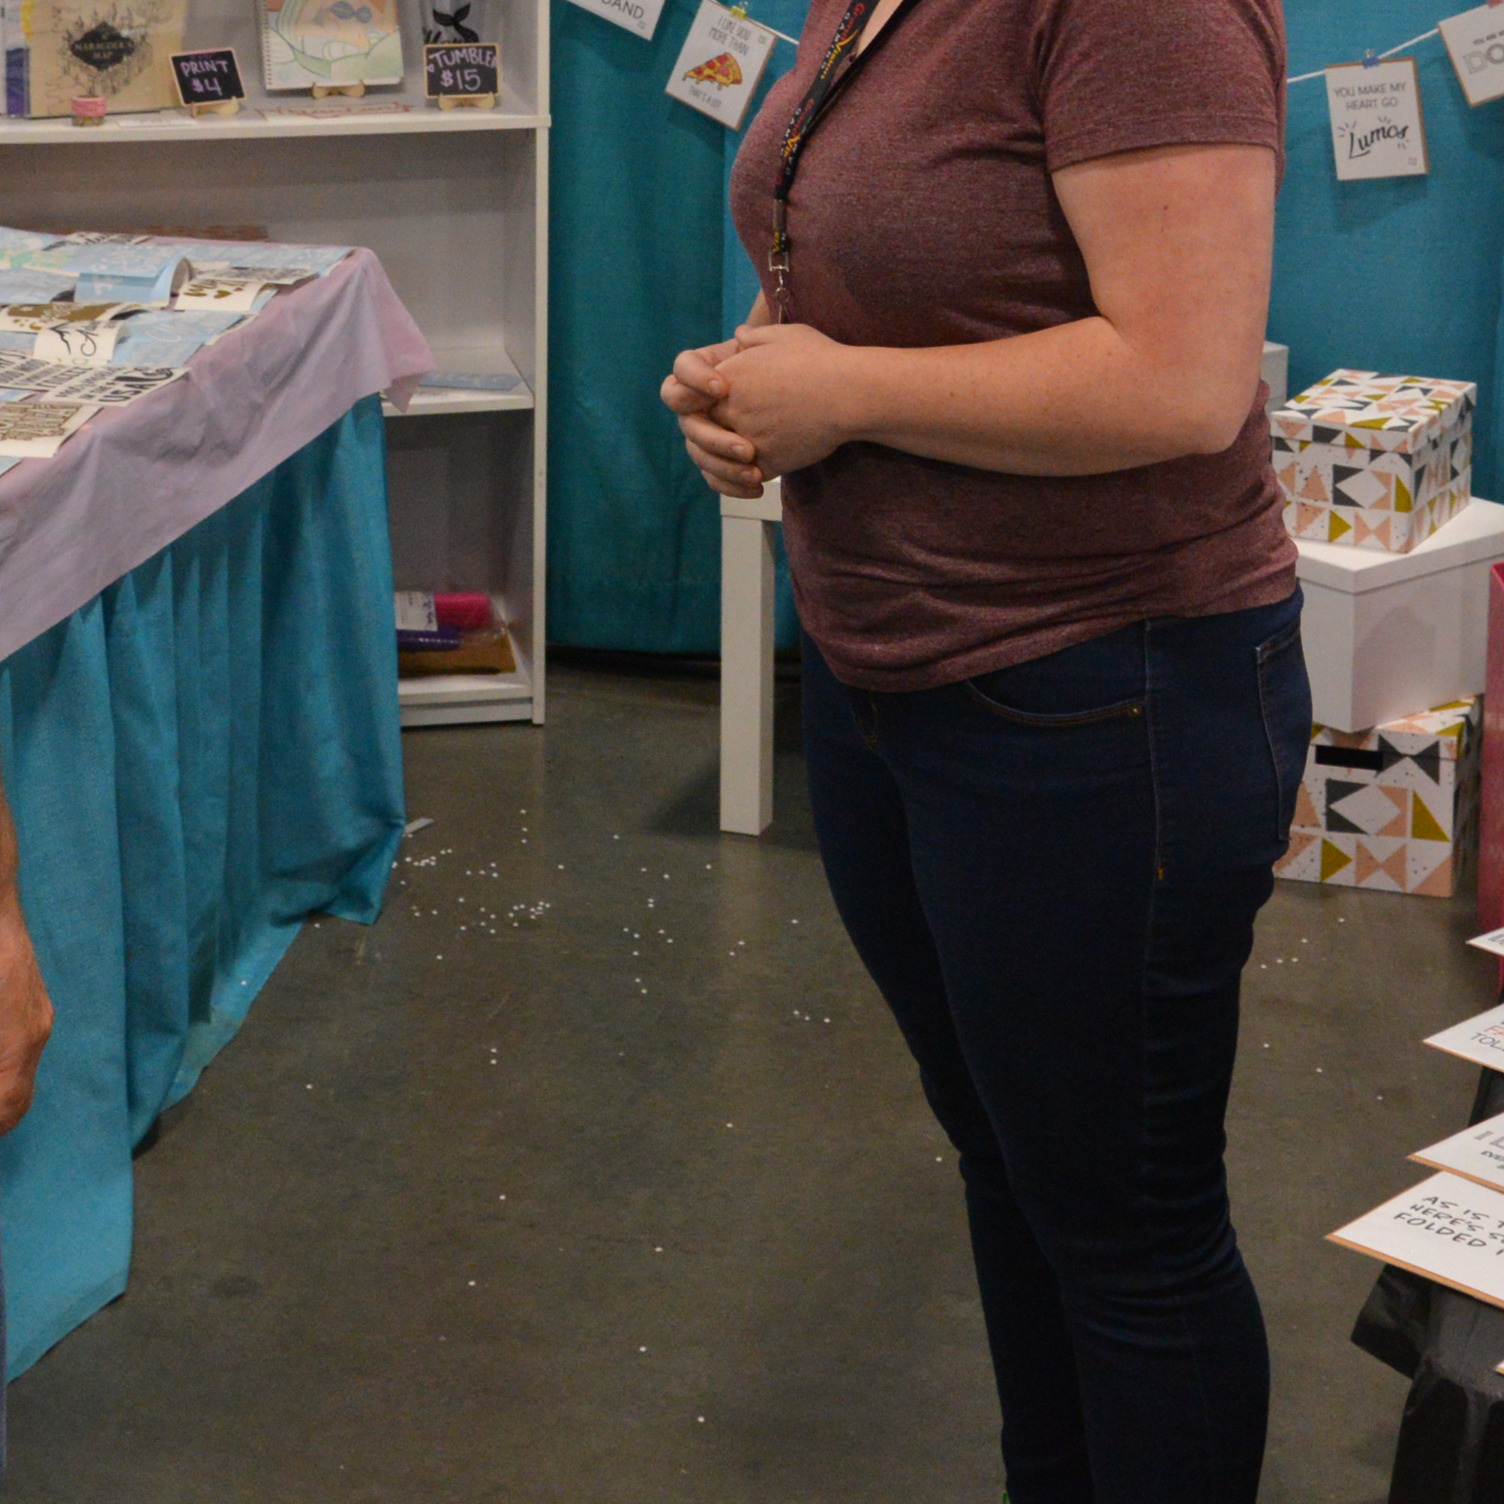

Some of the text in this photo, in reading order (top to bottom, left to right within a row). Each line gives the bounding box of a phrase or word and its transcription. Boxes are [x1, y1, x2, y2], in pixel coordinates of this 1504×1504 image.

[179, 59, 230, 79] PRINT
[439, 68, 483, 92] $15
[192, 77, 223, 97] $4
[1333, 81, 1407, 99] YOU MAKE MY
[1345, 96, 1400, 112] HEART GO
[1347, 123, 1410, 160] Lumos
[1409, 1202, 1485, 1233] HERE'S
[1421, 1194, 1455, 1210] AS
[1462, 1208, 1491, 1223] IS
[1392, 1211, 1490, 1250] FOLDED
